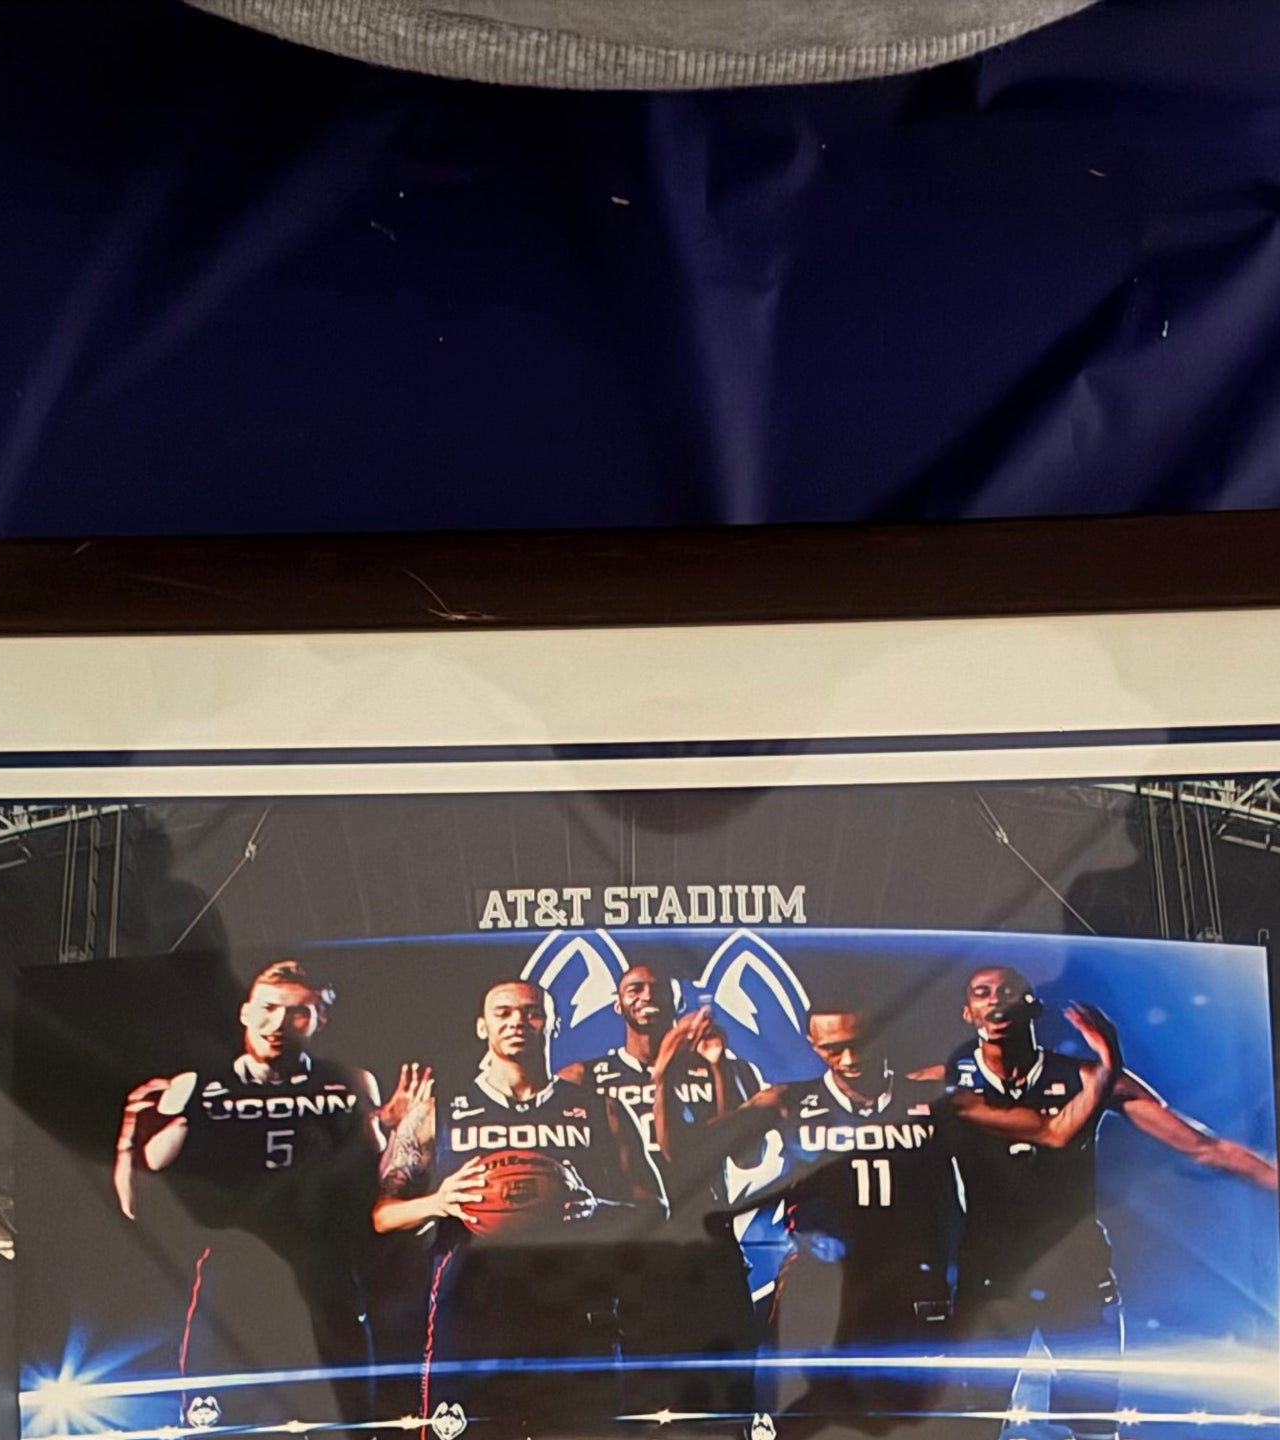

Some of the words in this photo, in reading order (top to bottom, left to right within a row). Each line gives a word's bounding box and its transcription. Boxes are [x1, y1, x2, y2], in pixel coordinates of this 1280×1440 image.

[479, 888, 591, 929] AT&T
[604, 885, 807, 925] STADIUM
[202, 1095, 357, 1120] UCONN
[265, 1129, 295, 1168] 5
[451, 1124, 591, 1152] UCONN
[799, 1124, 934, 1152] UCONN
[851, 1159, 891, 1207] 11
